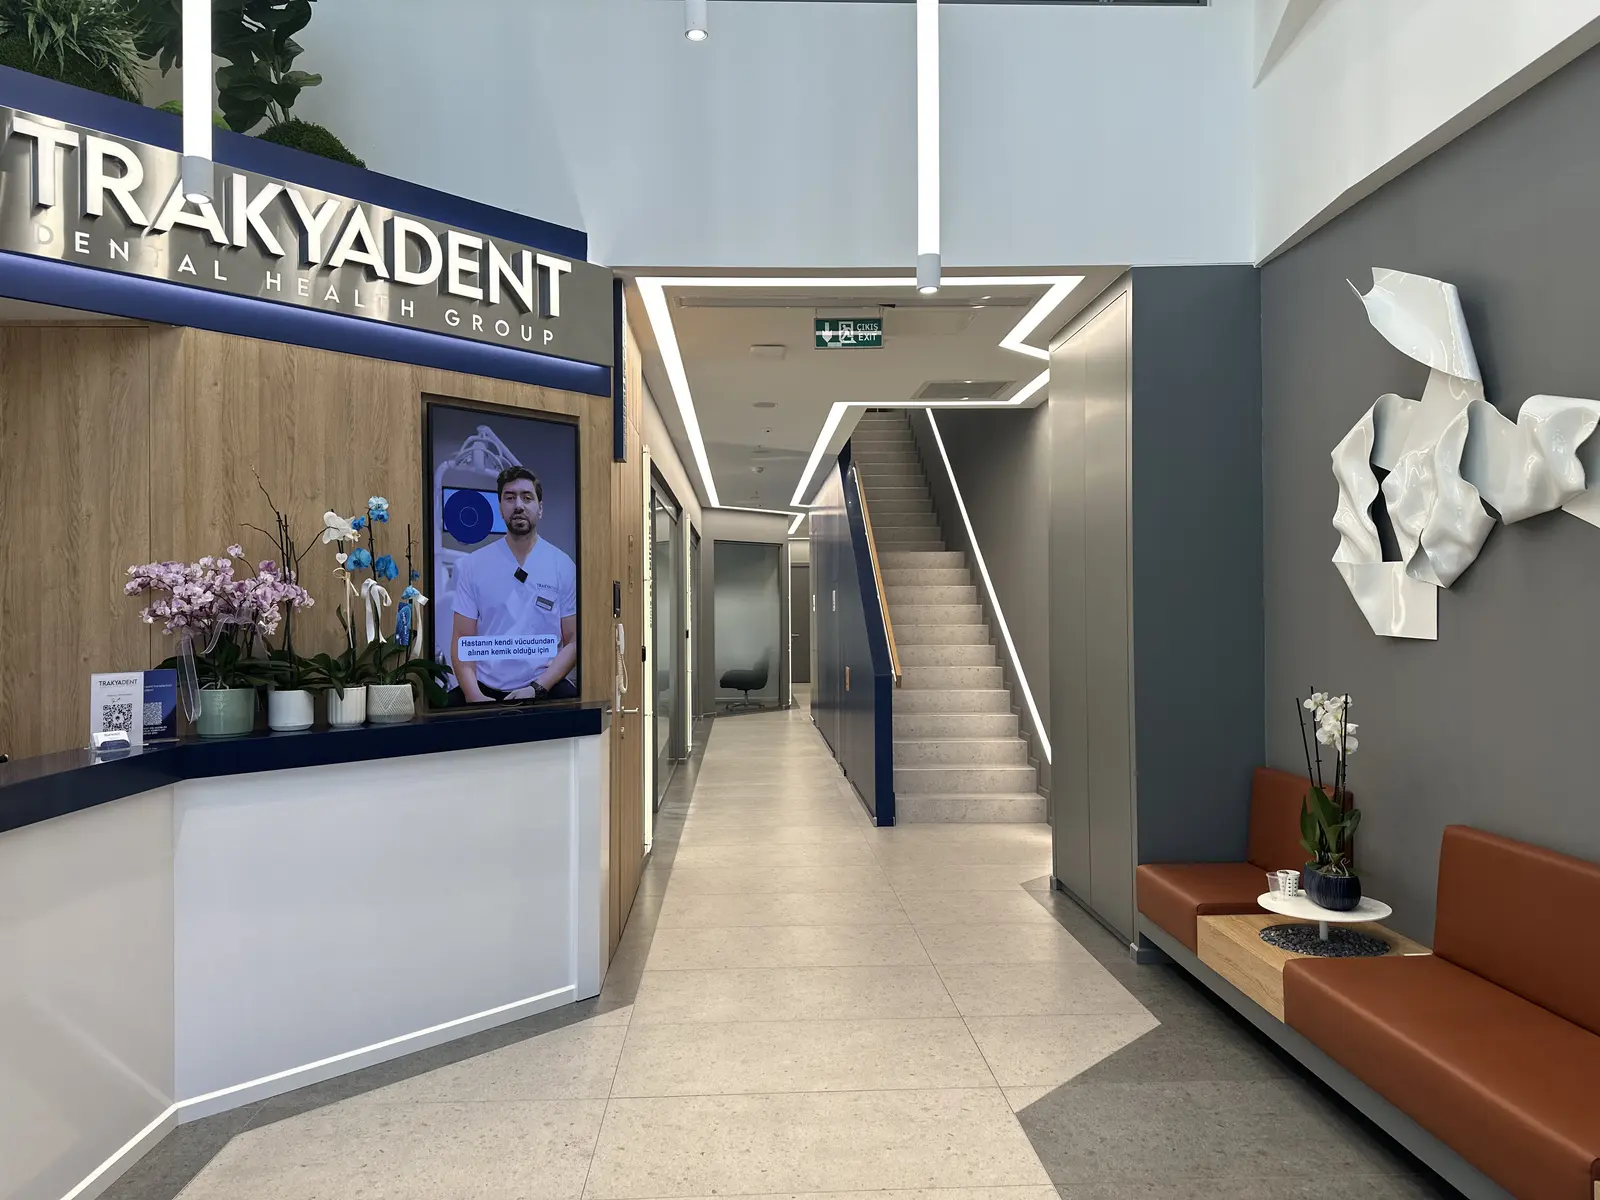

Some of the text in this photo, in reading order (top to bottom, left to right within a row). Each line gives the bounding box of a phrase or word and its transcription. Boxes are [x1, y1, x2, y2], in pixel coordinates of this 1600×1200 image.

[12, 116, 573, 317] TRAKYADENT
[35, 225, 555, 346] DENTAL HEALTH GROUP
[857, 323, 879, 332] ÇIKIŞ
[859, 333, 877, 341] EXIT
[461, 639, 493, 647] Hastanın
[513, 647, 536, 656] olduğu
[537, 647, 550, 655] için
